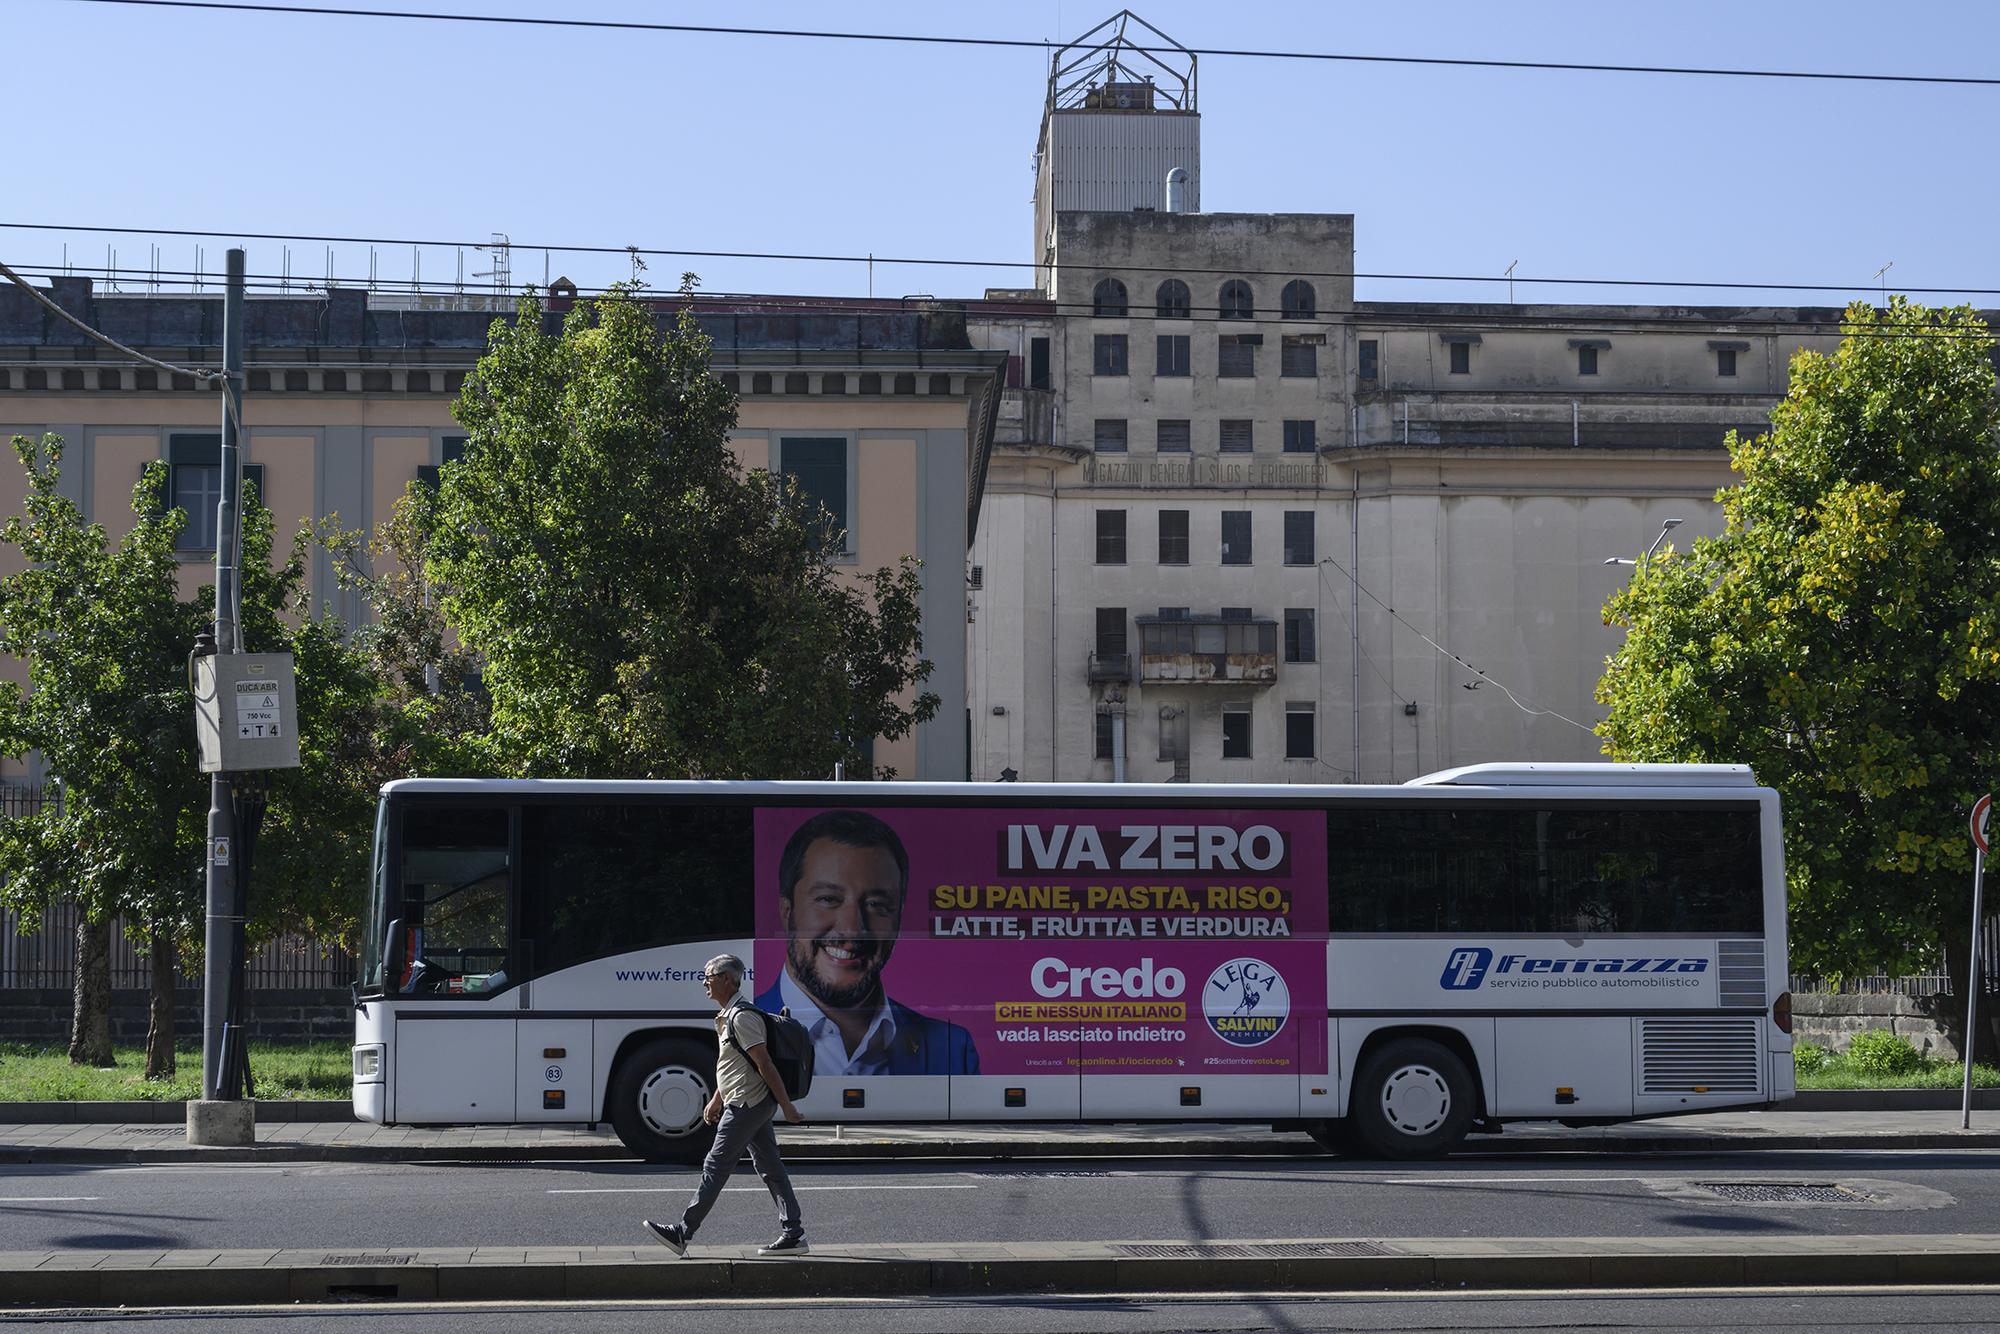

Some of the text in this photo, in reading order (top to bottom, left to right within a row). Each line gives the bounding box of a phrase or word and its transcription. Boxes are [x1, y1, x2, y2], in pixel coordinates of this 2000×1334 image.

[1082, 463, 1328, 483] MAGAZZINI GENERALI SILOS E FRIGORIFERI
[237, 683, 277, 692] DUCA ABR
[255, 725, 264, 736] T
[270, 725, 278, 736] 4
[1007, 824, 1285, 871] IVA ZERO
[935, 885, 1290, 914] SU PANE, PASTA, RISO,
[935, 916, 1290, 940] LATTE, FRUTTA E VERDURA
[1496, 955, 1709, 974] Ferrazza
[616, 967, 754, 981] www.ferrait
[1030, 957, 1186, 998] Credo
[1212, 963, 1276, 992] LEGA
[1490, 976, 1700, 990] servizio pubblico automobilistico
[999, 1006, 1183, 1019] CHE NESSUN ITALIANO
[1216, 1017, 1277, 1031] SALVINI
[996, 1027, 1186, 1042] vada lasciato indietro
[1203, 1057, 1290, 1066] #25settembrevotoLega
[548, 1069, 560, 1078] 83
